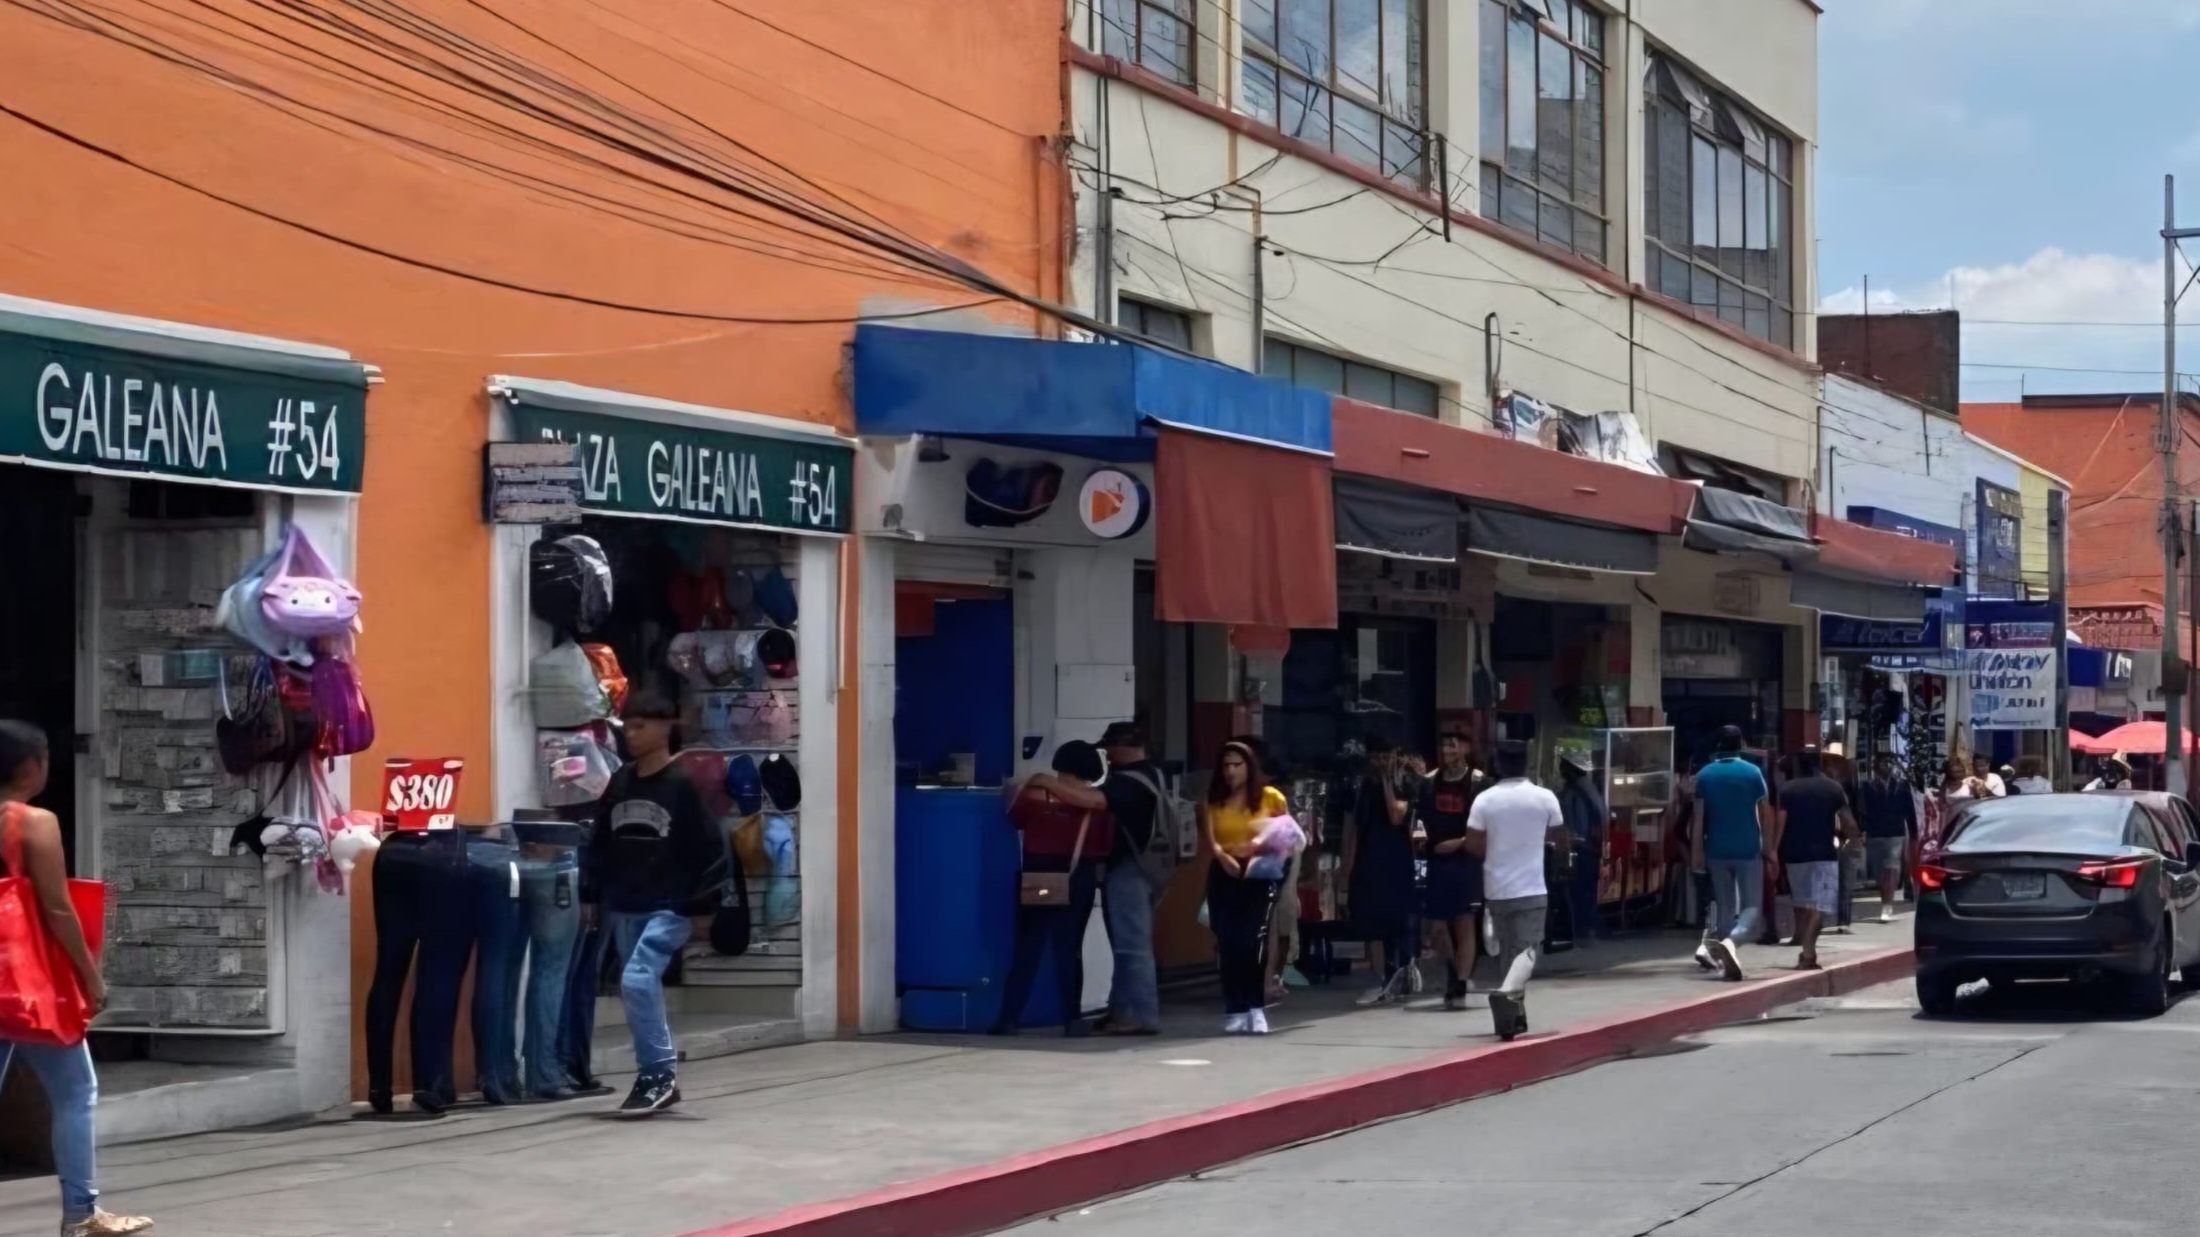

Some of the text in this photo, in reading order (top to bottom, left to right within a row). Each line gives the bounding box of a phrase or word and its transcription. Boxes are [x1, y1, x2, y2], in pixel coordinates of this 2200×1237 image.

[37, 362, 341, 481] GALEANA #54
[541, 427, 836, 528] AZA GALEANA #54
[385, 774, 454, 813] $380
